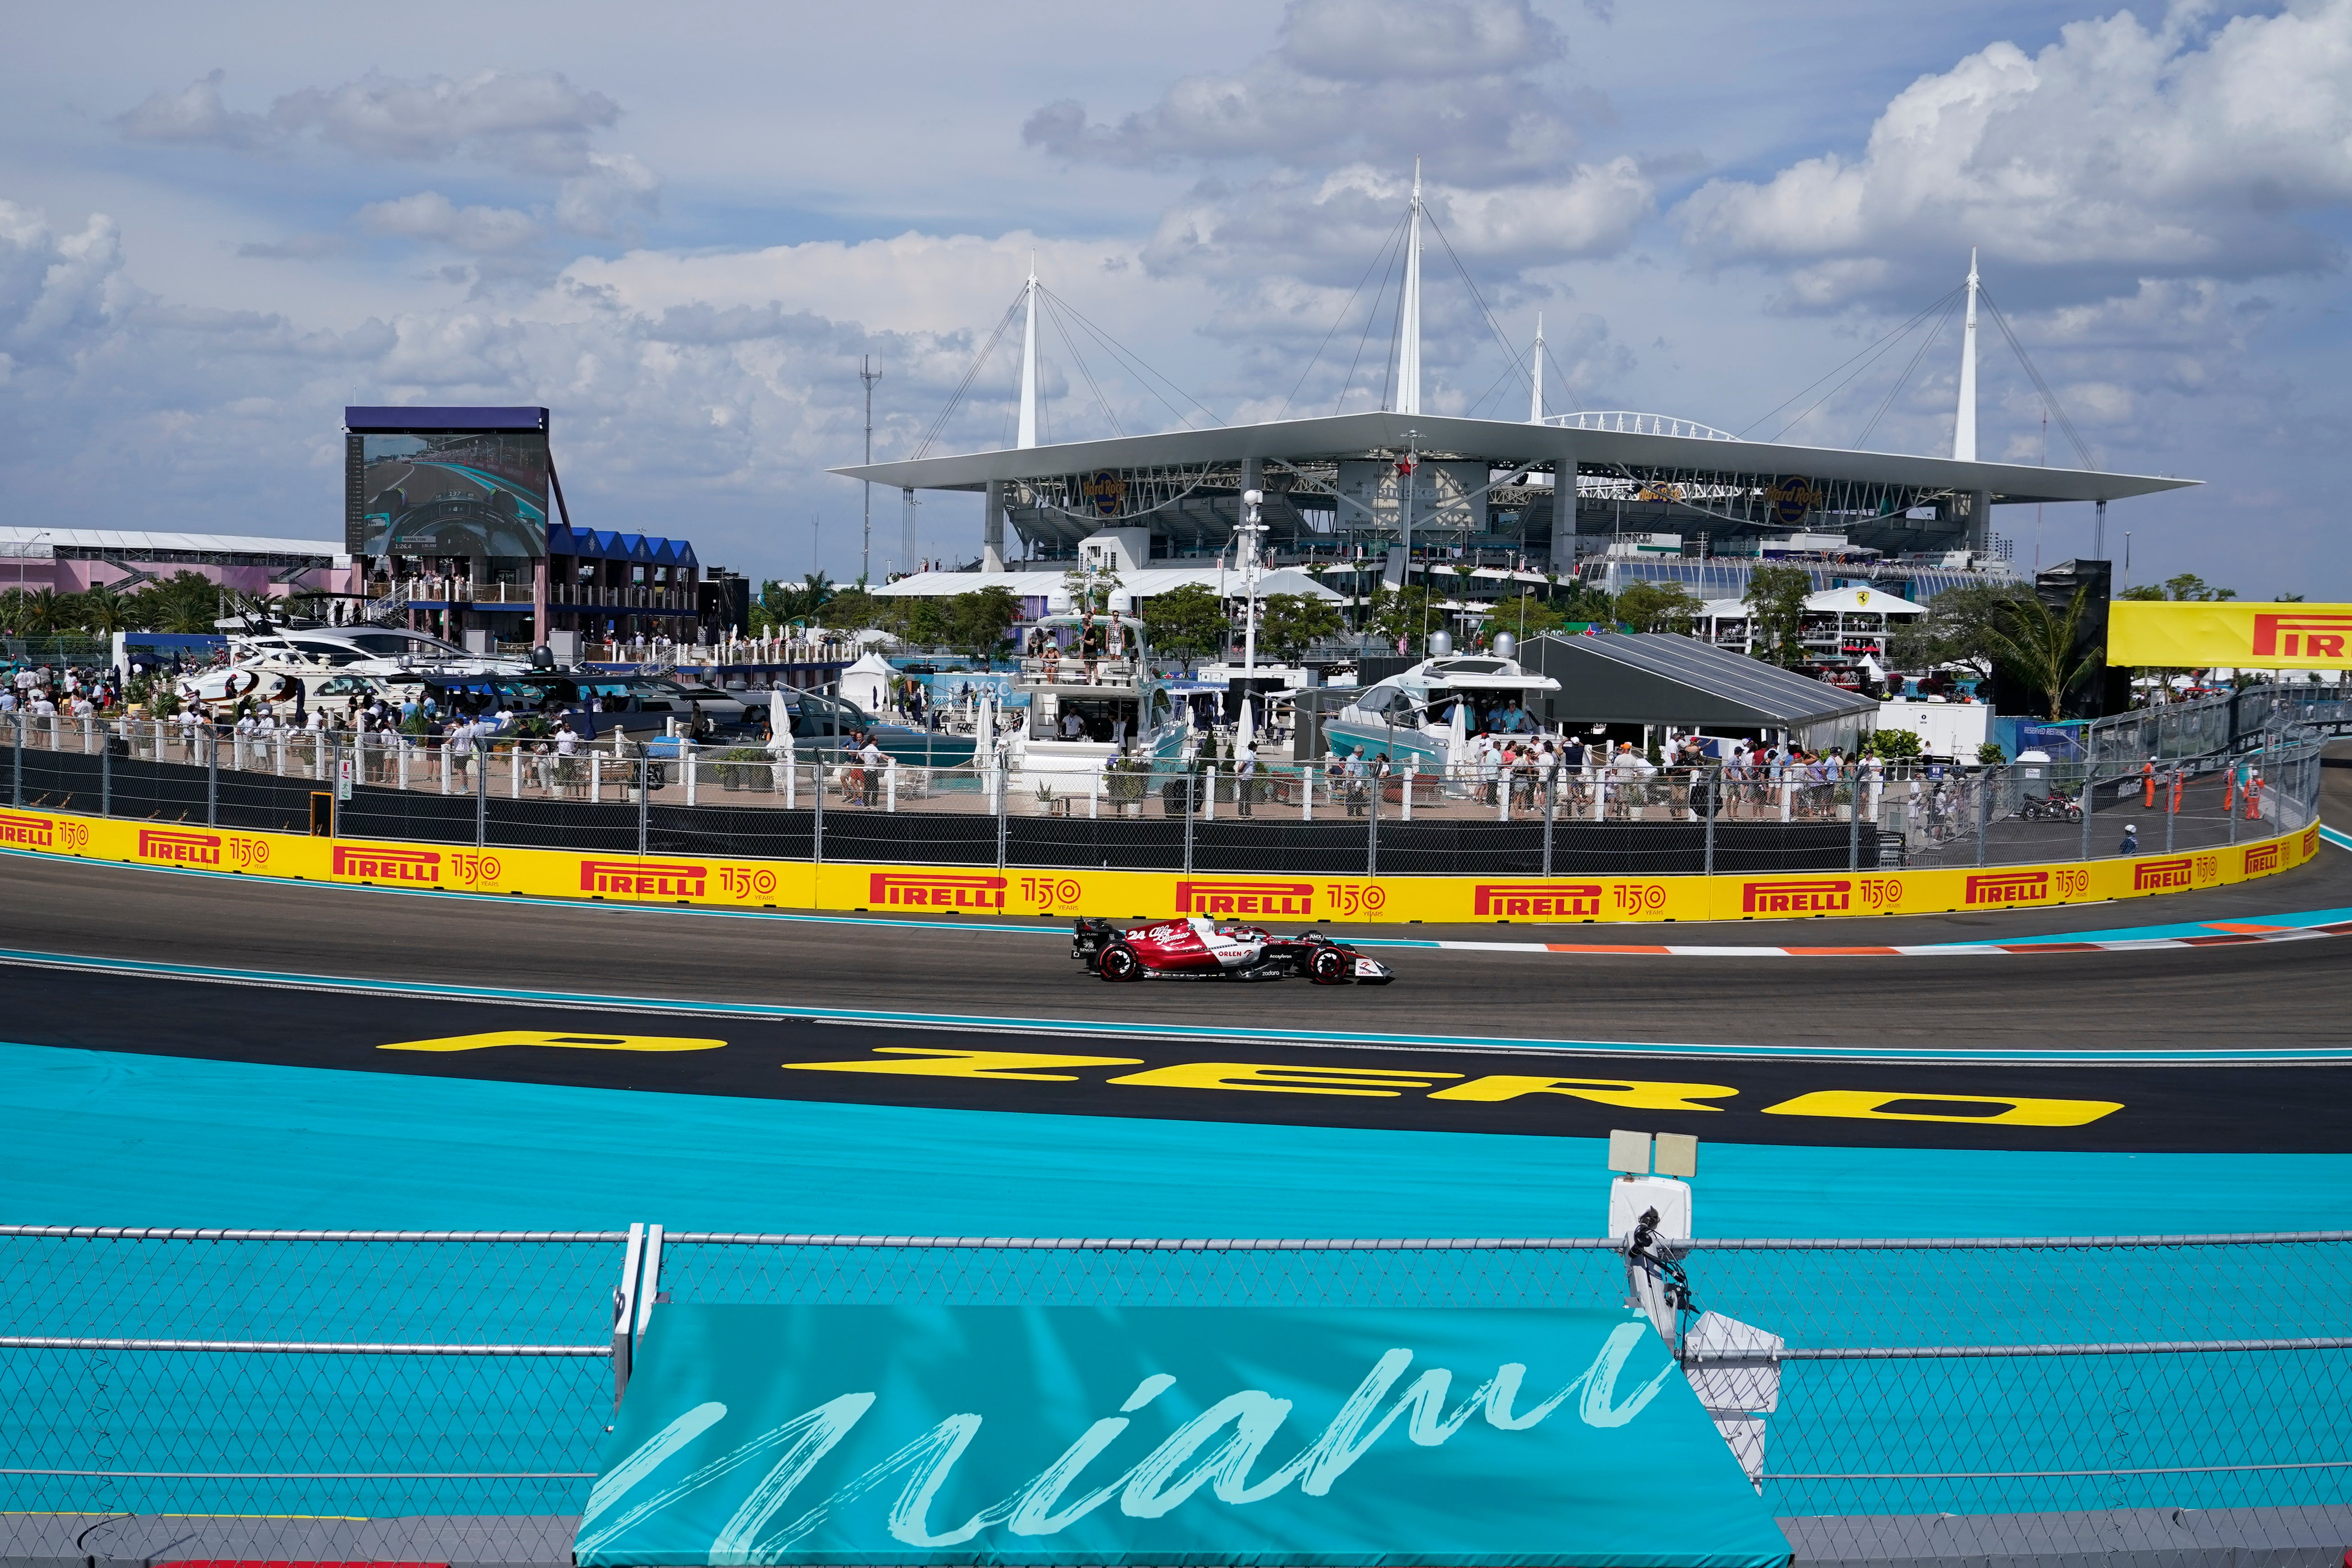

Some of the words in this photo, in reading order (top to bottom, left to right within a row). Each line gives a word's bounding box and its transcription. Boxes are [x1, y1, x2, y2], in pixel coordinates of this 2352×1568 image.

[1083, 480, 1105, 496] Hard
[1105, 479, 1126, 498] Rock
[1766, 485, 1794, 502] Hard
[1795, 486, 1822, 507] Rock
[970, 681, 1011, 696] MSC
[2024, 727, 2046, 735] RESERVED
[59, 822, 88, 849] 150
[139, 829, 221, 864] PIRELLI
[230, 838, 269, 867] 150
[333, 846, 441, 882] PIRELLI
[452, 854, 501, 884] 150
[2134, 859, 2192, 890] PIRELLI
[2197, 856, 2217, 887] 150
[2245, 844, 2278, 874] PIRELLI
[580, 861, 707, 896] PIRELLI
[720, 868, 776, 899] 150
[870, 873, 1008, 908] PIRELLI
[1021, 878, 1081, 909] 150
[1743, 881, 1851, 912] PIRELLI
[1861, 880, 1902, 909] 150
[1965, 872, 2049, 904] PIRELLI
[2056, 870, 2089, 898] 150
[1175, 881, 1314, 914] PIRELLI
[1327, 885, 1385, 916] 150
[1475, 885, 1602, 915] PIRELLI
[1614, 885, 1666, 915] 150
[1128, 930, 1146, 940] 24
[1152, 932, 1191, 945] Romeo
[378, 1031, 727, 1051] P
[782, 1047, 2125, 1126] ZERO
[577, 1309, 1676, 1567] Miami
